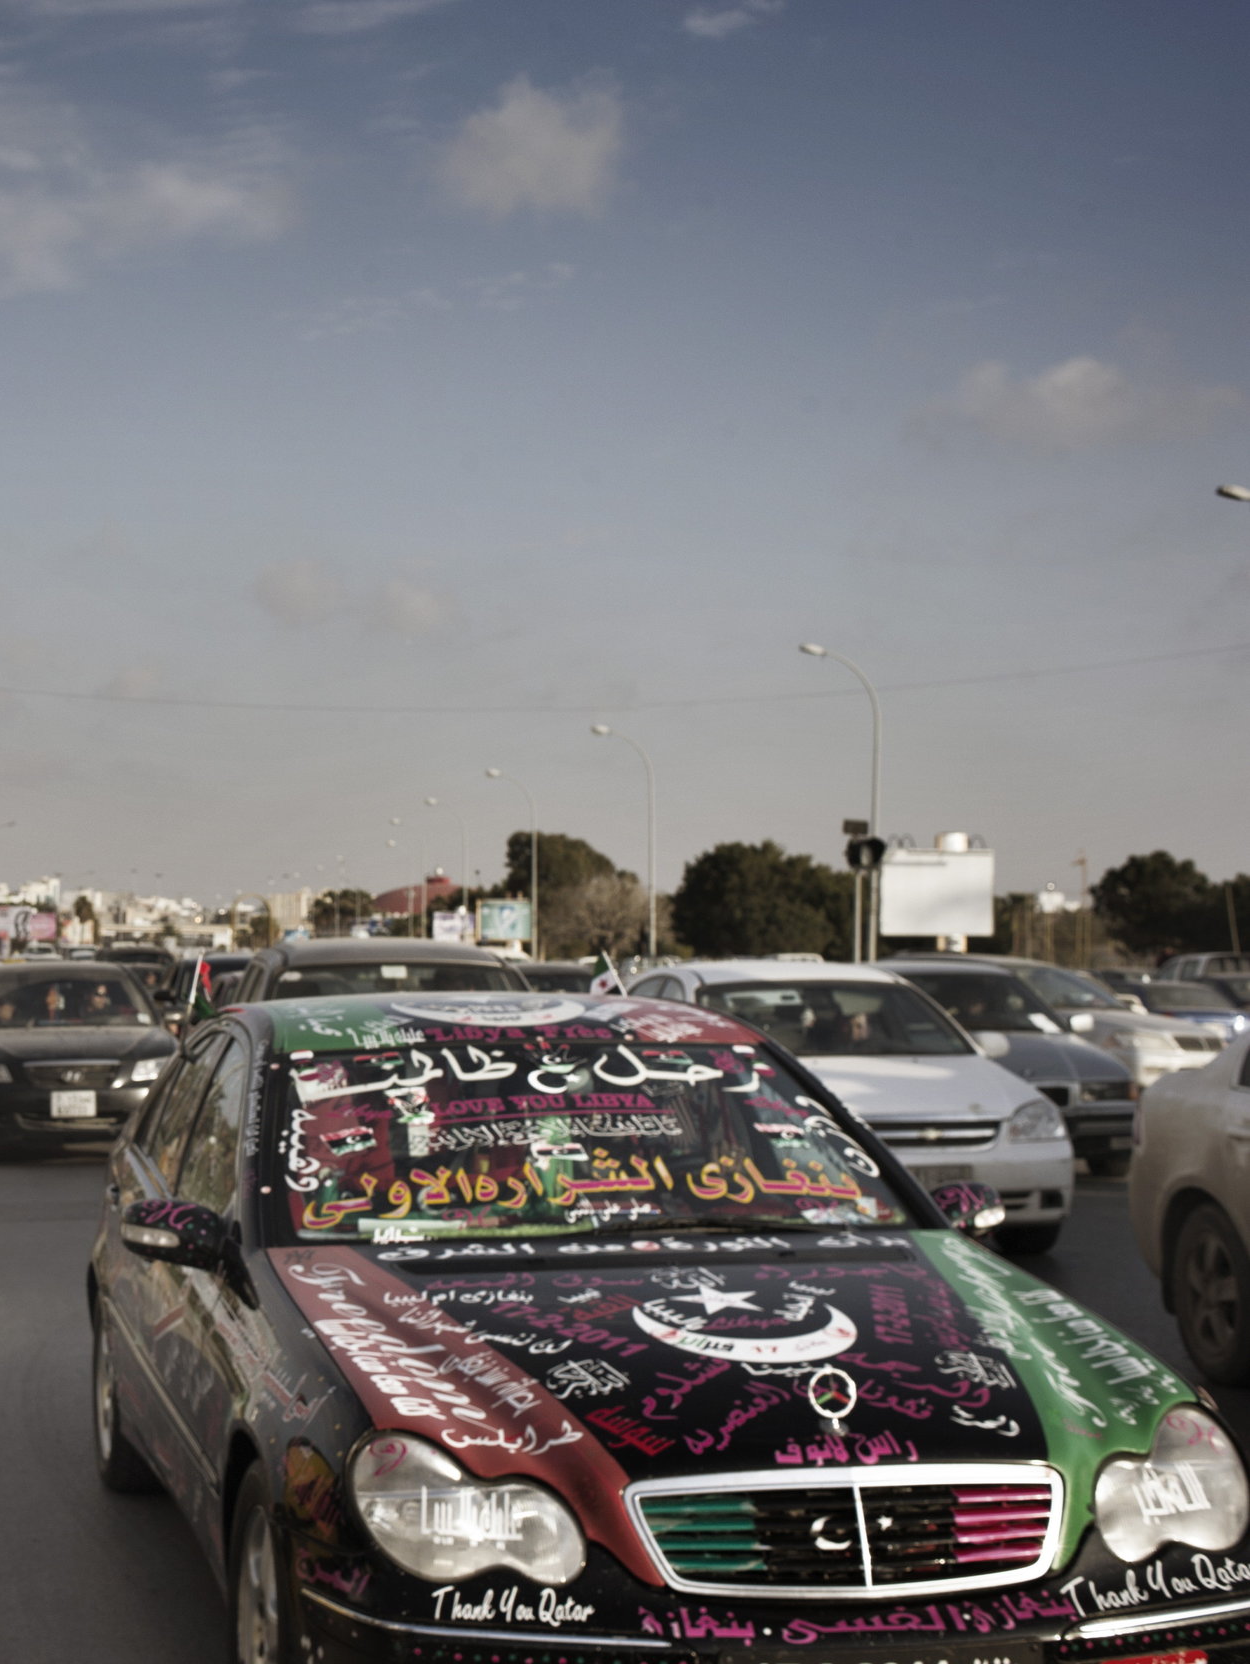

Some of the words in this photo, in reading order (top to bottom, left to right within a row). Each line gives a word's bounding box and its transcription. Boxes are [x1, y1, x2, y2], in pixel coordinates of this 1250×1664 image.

[424, 1026, 526, 1042] Libya
[431, 1099, 505, 1117] LOVE
[508, 1095, 565, 1110] YOU
[573, 1093, 655, 1108] LIBYA
[287, 1262, 502, 1432] Freedom
[440, 1420, 584, 1456] طرابلس
[1059, 1575, 1149, 1618] Thank
[1146, 1559, 1200, 1600] You
[1190, 1552, 1250, 1592] Qata
[431, 1585, 496, 1621] Thank
[498, 1586, 537, 1623] You
[537, 1588, 596, 1627] Qatar
